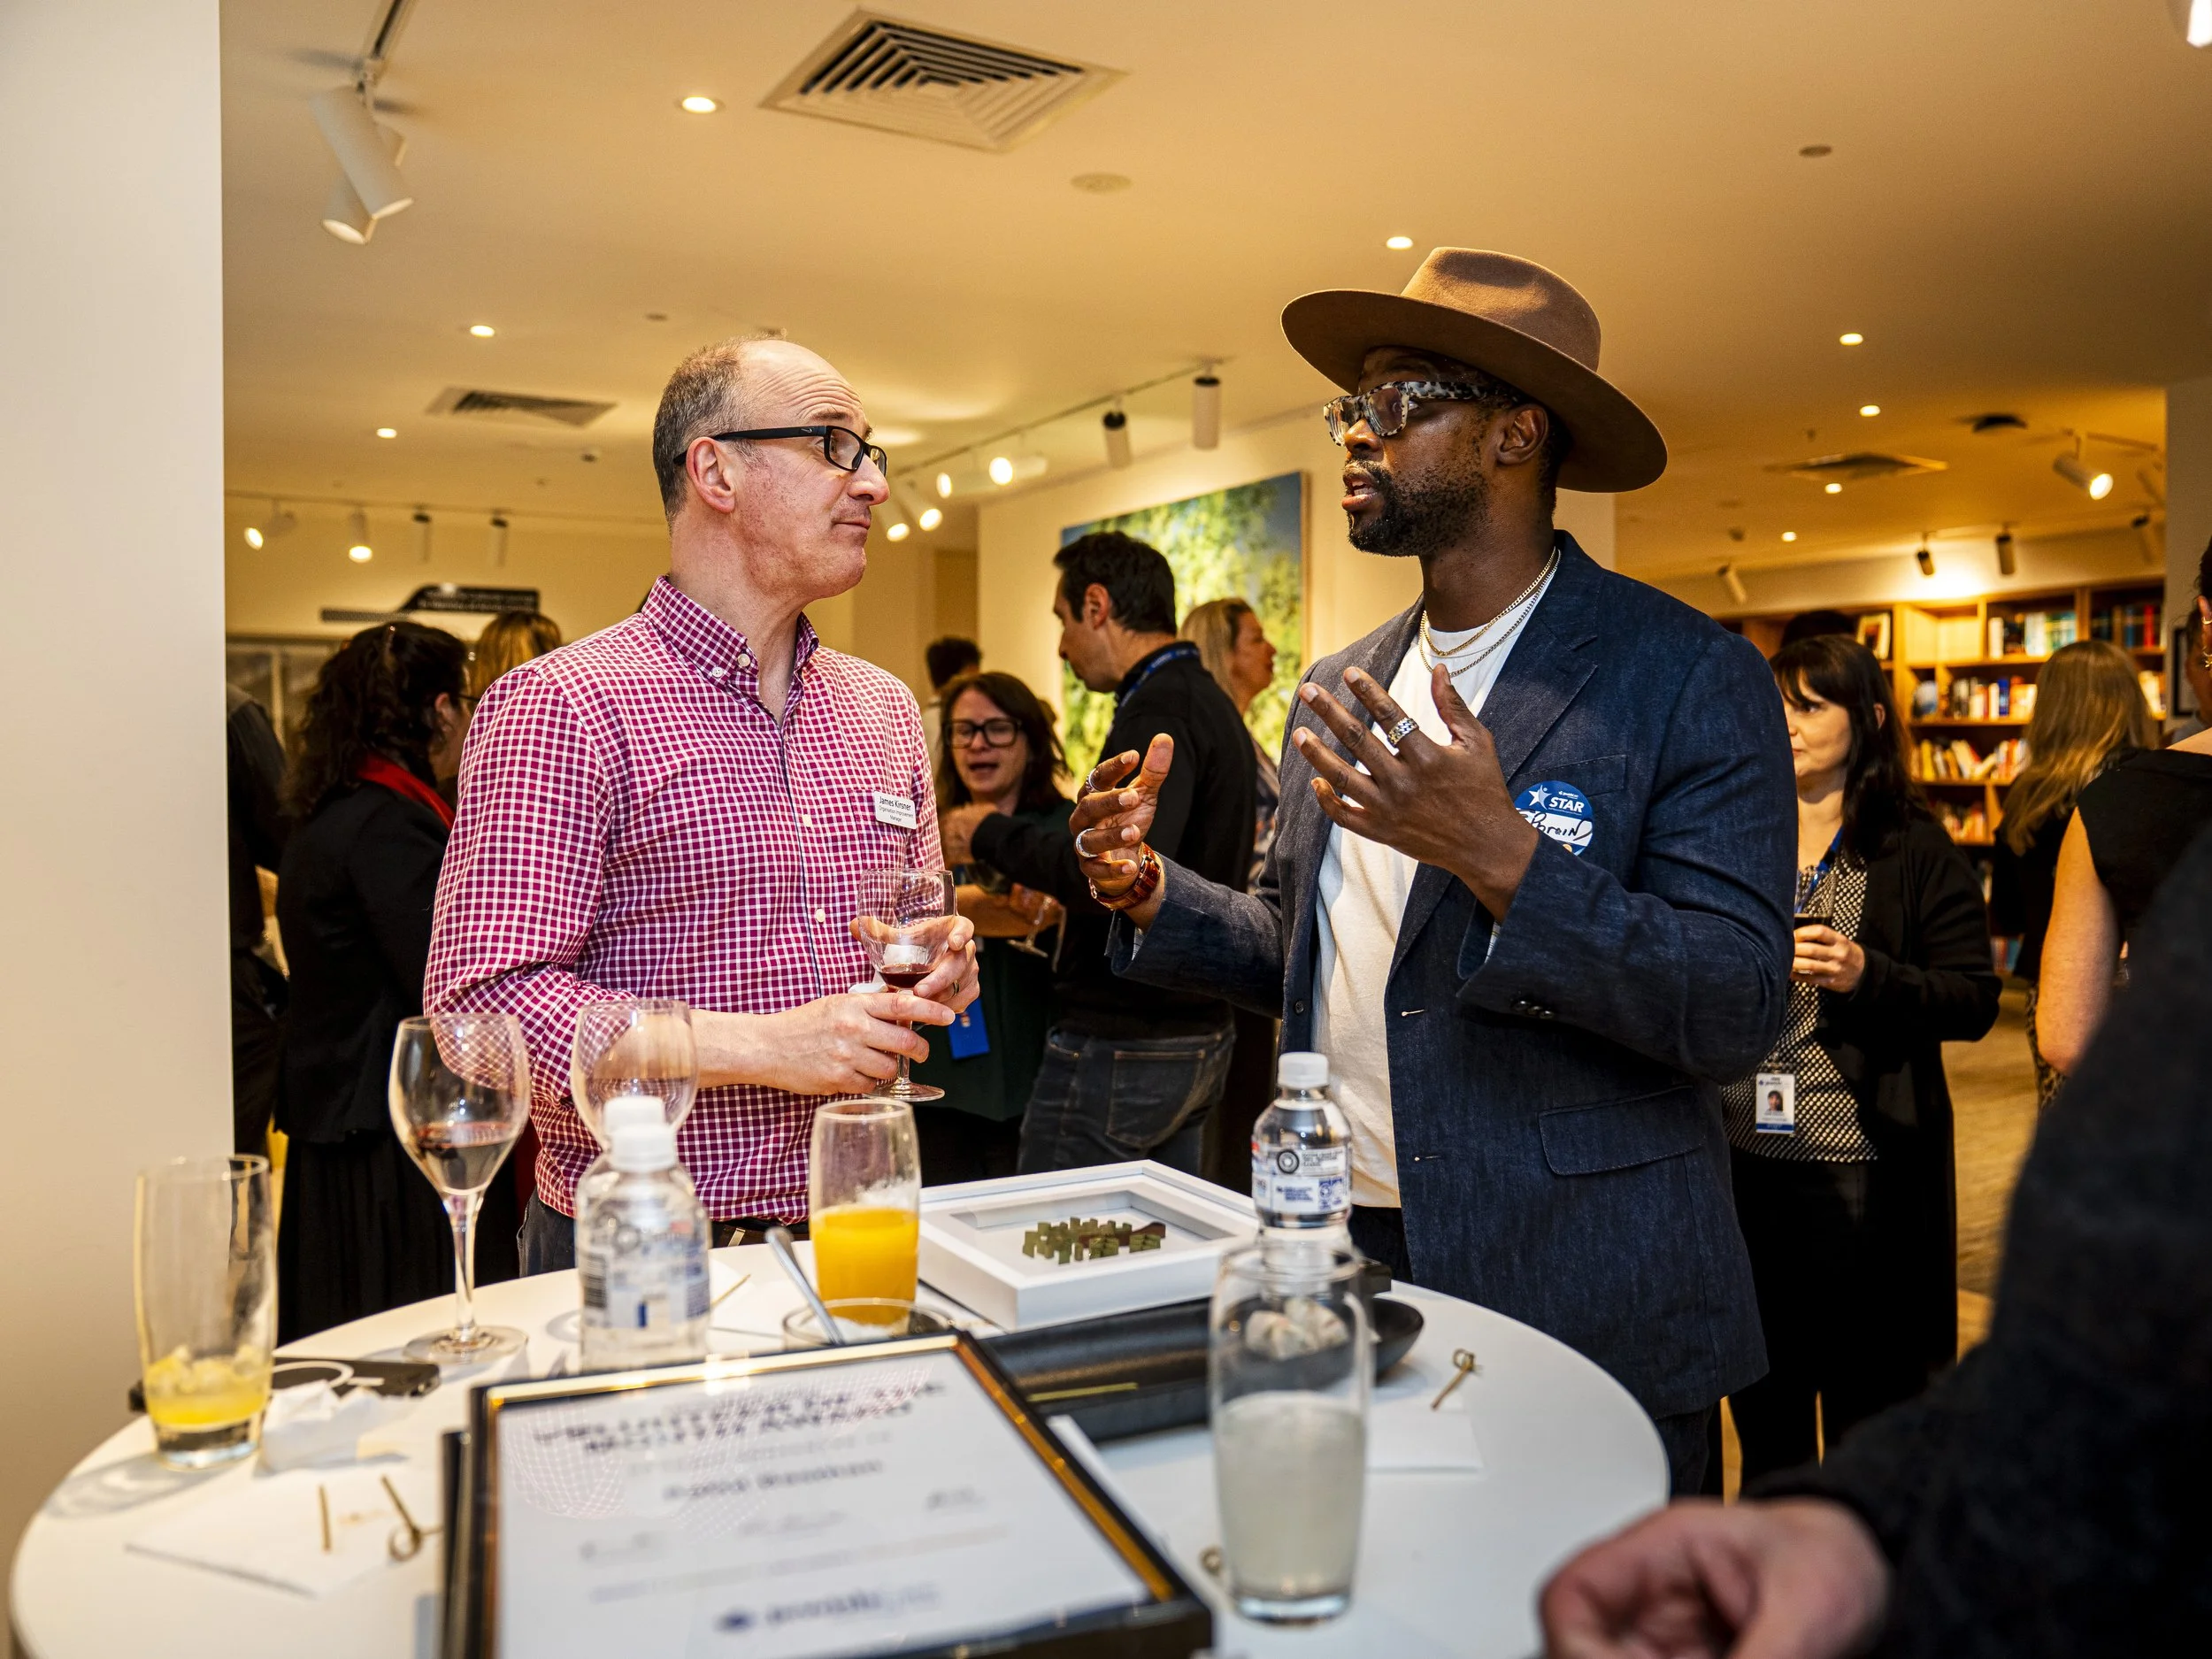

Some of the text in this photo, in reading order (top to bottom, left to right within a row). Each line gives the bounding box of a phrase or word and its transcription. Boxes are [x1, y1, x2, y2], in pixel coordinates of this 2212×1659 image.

[879, 796, 910, 810] James Kirsner
[1548, 796, 1585, 813] STAR
